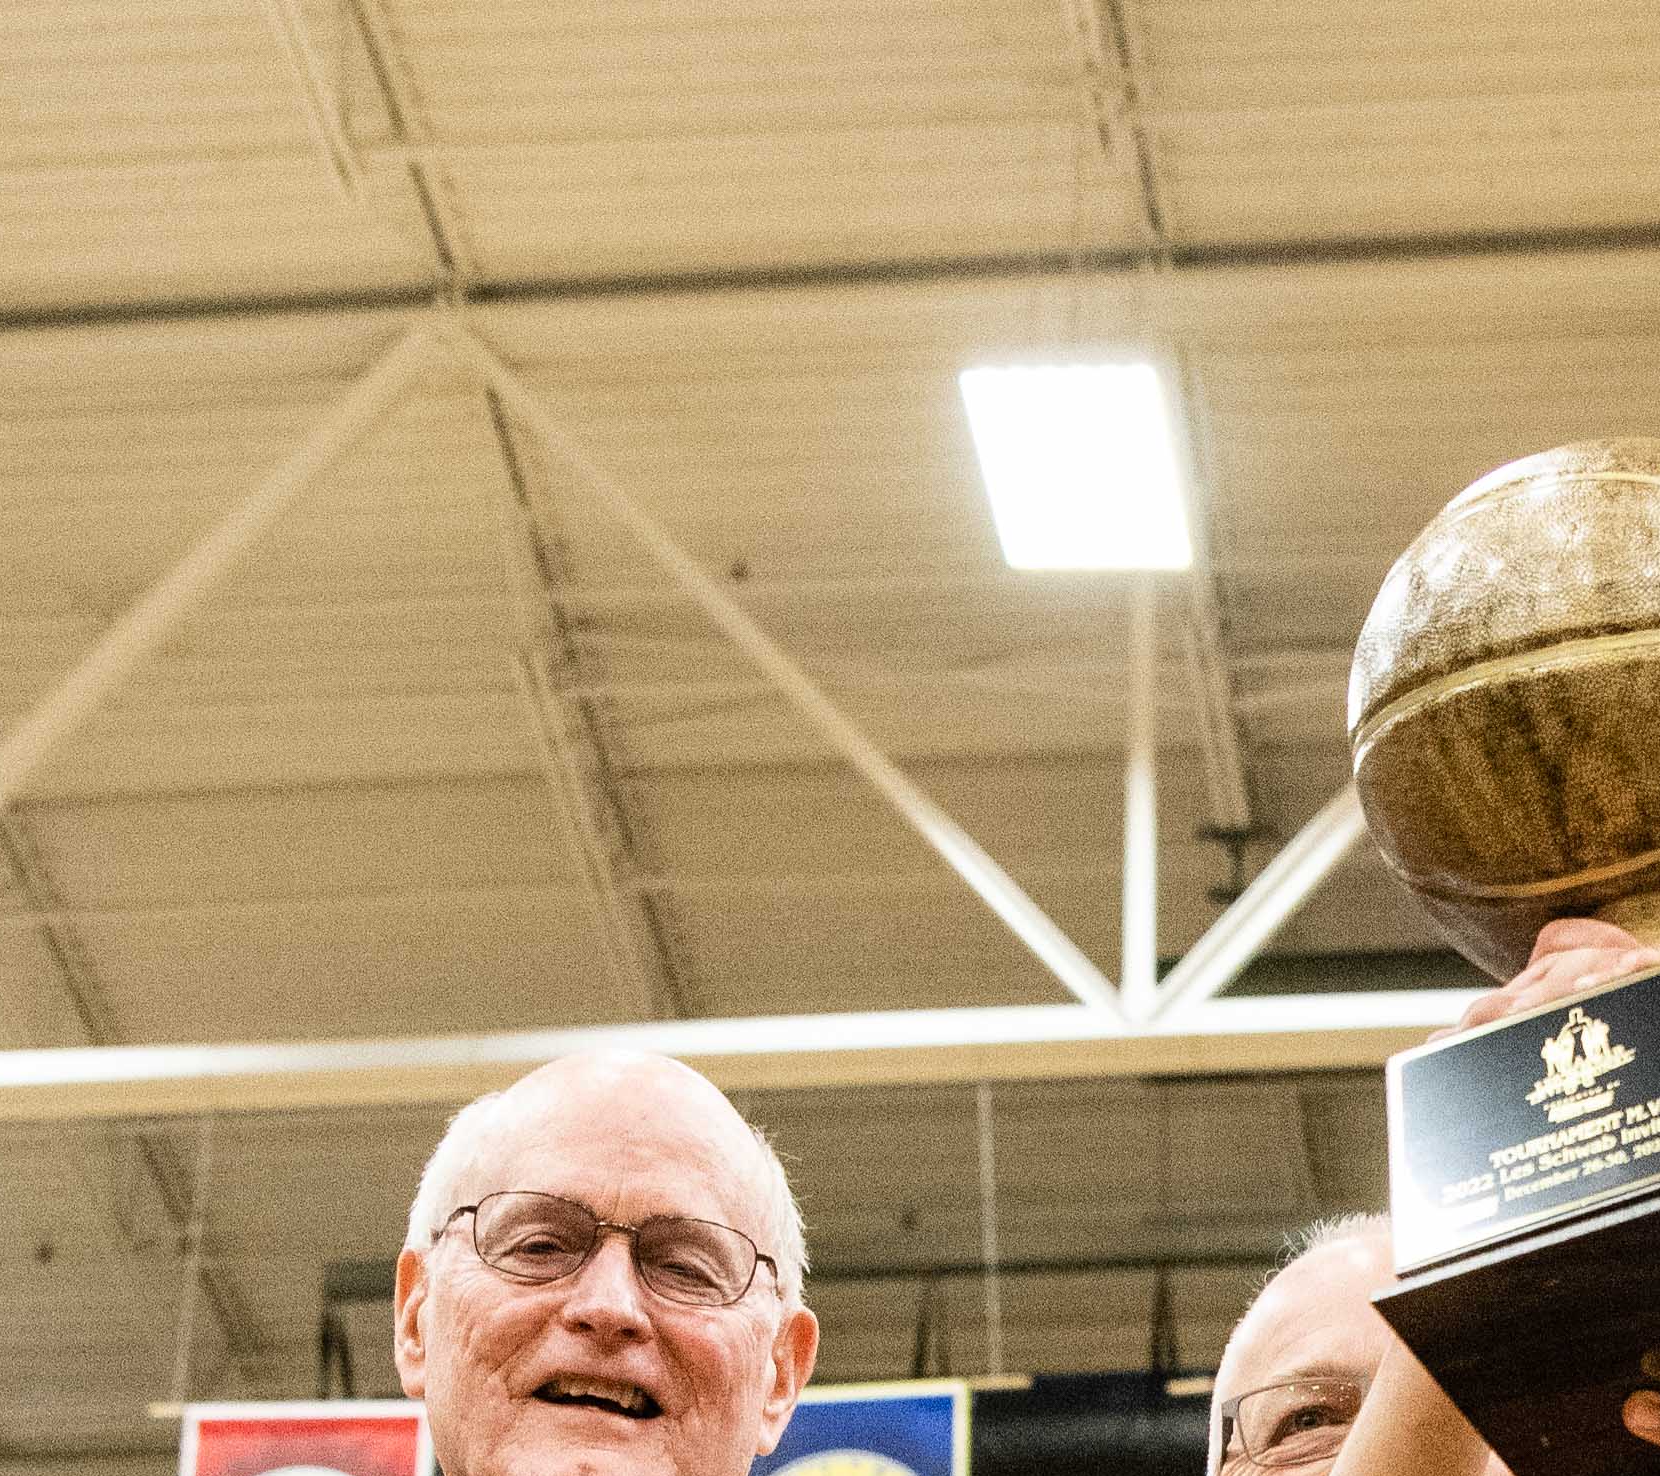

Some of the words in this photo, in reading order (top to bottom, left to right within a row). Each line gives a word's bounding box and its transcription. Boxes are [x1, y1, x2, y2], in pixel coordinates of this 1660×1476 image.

[1489, 1110, 1624, 1168] TOURNAMENT
[1499, 1162, 1535, 1184] Les
[1538, 1134, 1619, 1170] Schwab
